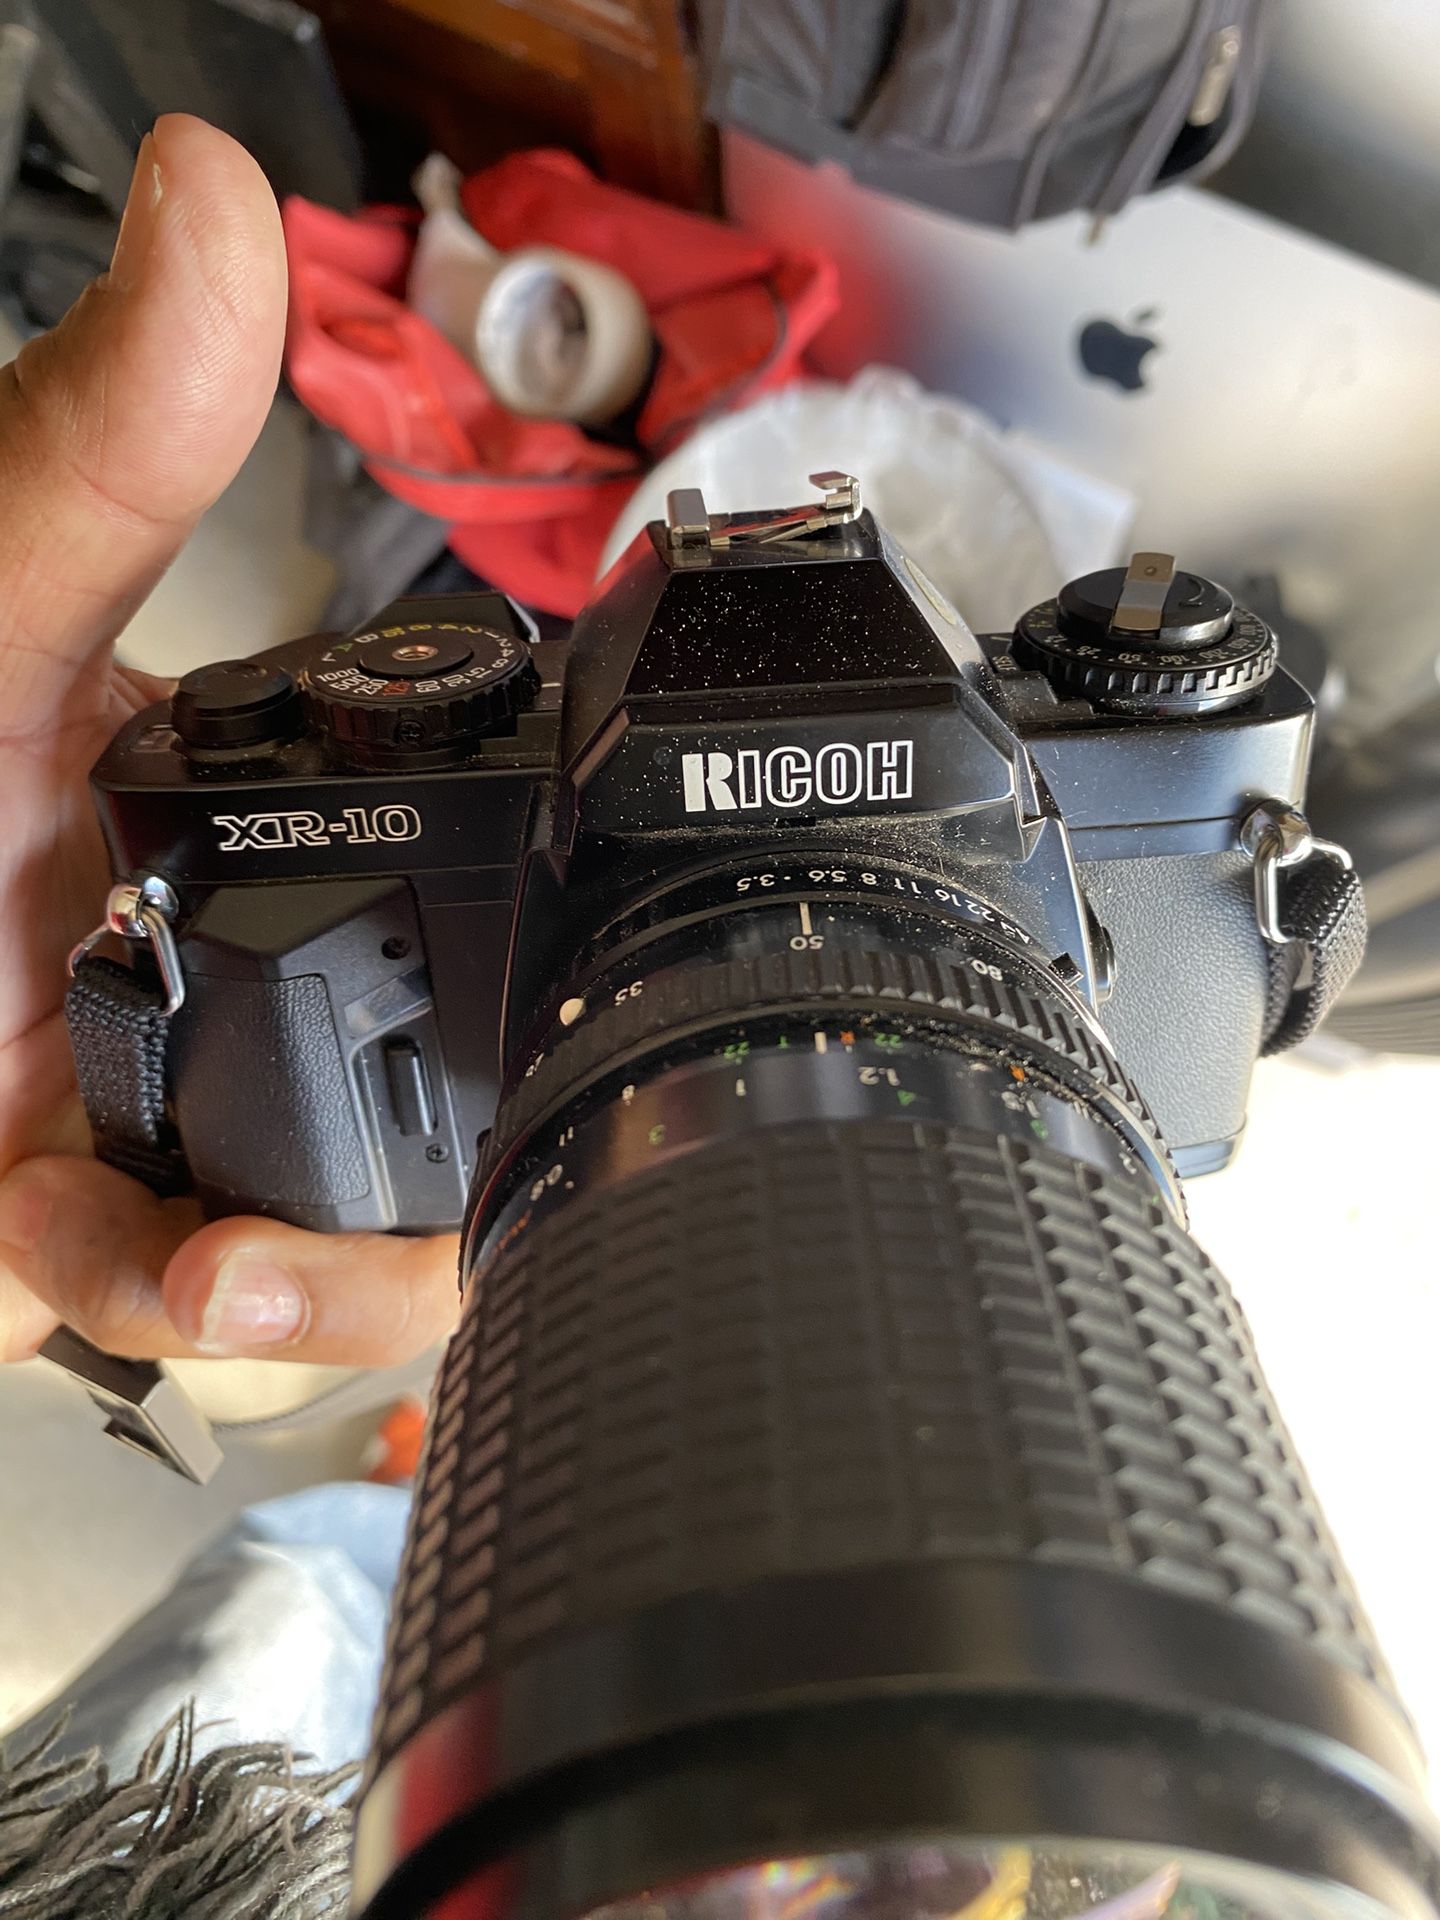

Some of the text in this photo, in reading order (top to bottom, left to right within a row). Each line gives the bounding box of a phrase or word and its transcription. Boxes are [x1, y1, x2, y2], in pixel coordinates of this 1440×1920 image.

[354, 633, 379, 643] B
[496, 638, 512, 648] 2
[498, 648, 515, 658] 4
[1118, 653, 1142, 662] 50
[492, 658, 508, 669] 8
[316, 667, 360, 683] 1000
[464, 666, 493, 679] 15
[329, 674, 370, 691] 500
[352, 678, 389, 696] 250
[383, 681, 412, 696] 125
[414, 680, 441, 694] 60
[442, 674, 472, 688] 30
[682, 740, 914, 813] RICOH
[213, 804, 421, 851] XR-10
[736, 874, 775, 892] 3.5
[808, 870, 847, 883] 5.6
[861, 872, 877, 886] 8
[894, 877, 922, 894] 11
[934, 888, 962, 908] 16
[965, 899, 995, 922] 22
[614, 935, 1003, 1006] 35 50 80
[858, 1066, 901, 1087] 1.2
